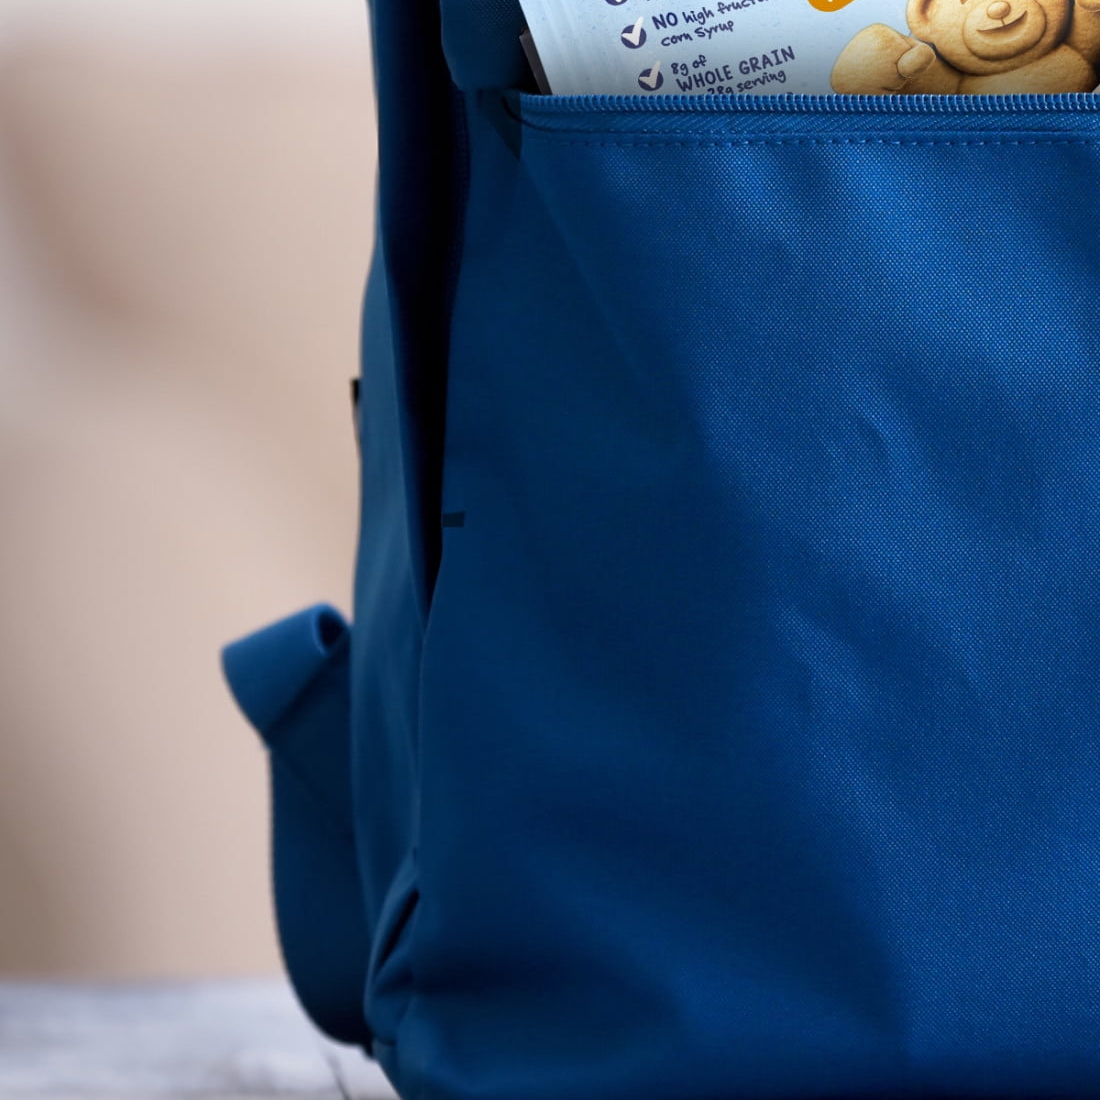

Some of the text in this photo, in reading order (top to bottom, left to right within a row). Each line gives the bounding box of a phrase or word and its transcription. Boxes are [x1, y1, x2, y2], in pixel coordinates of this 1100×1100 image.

[652, 12, 678, 30] NO
[682, 7, 714, 25] high
[661, 32, 692, 47] corn
[670, 55, 707, 75] 8g of
[676, 46, 795, 92] WHOLE GRAIN
[737, 70, 787, 92] serving
